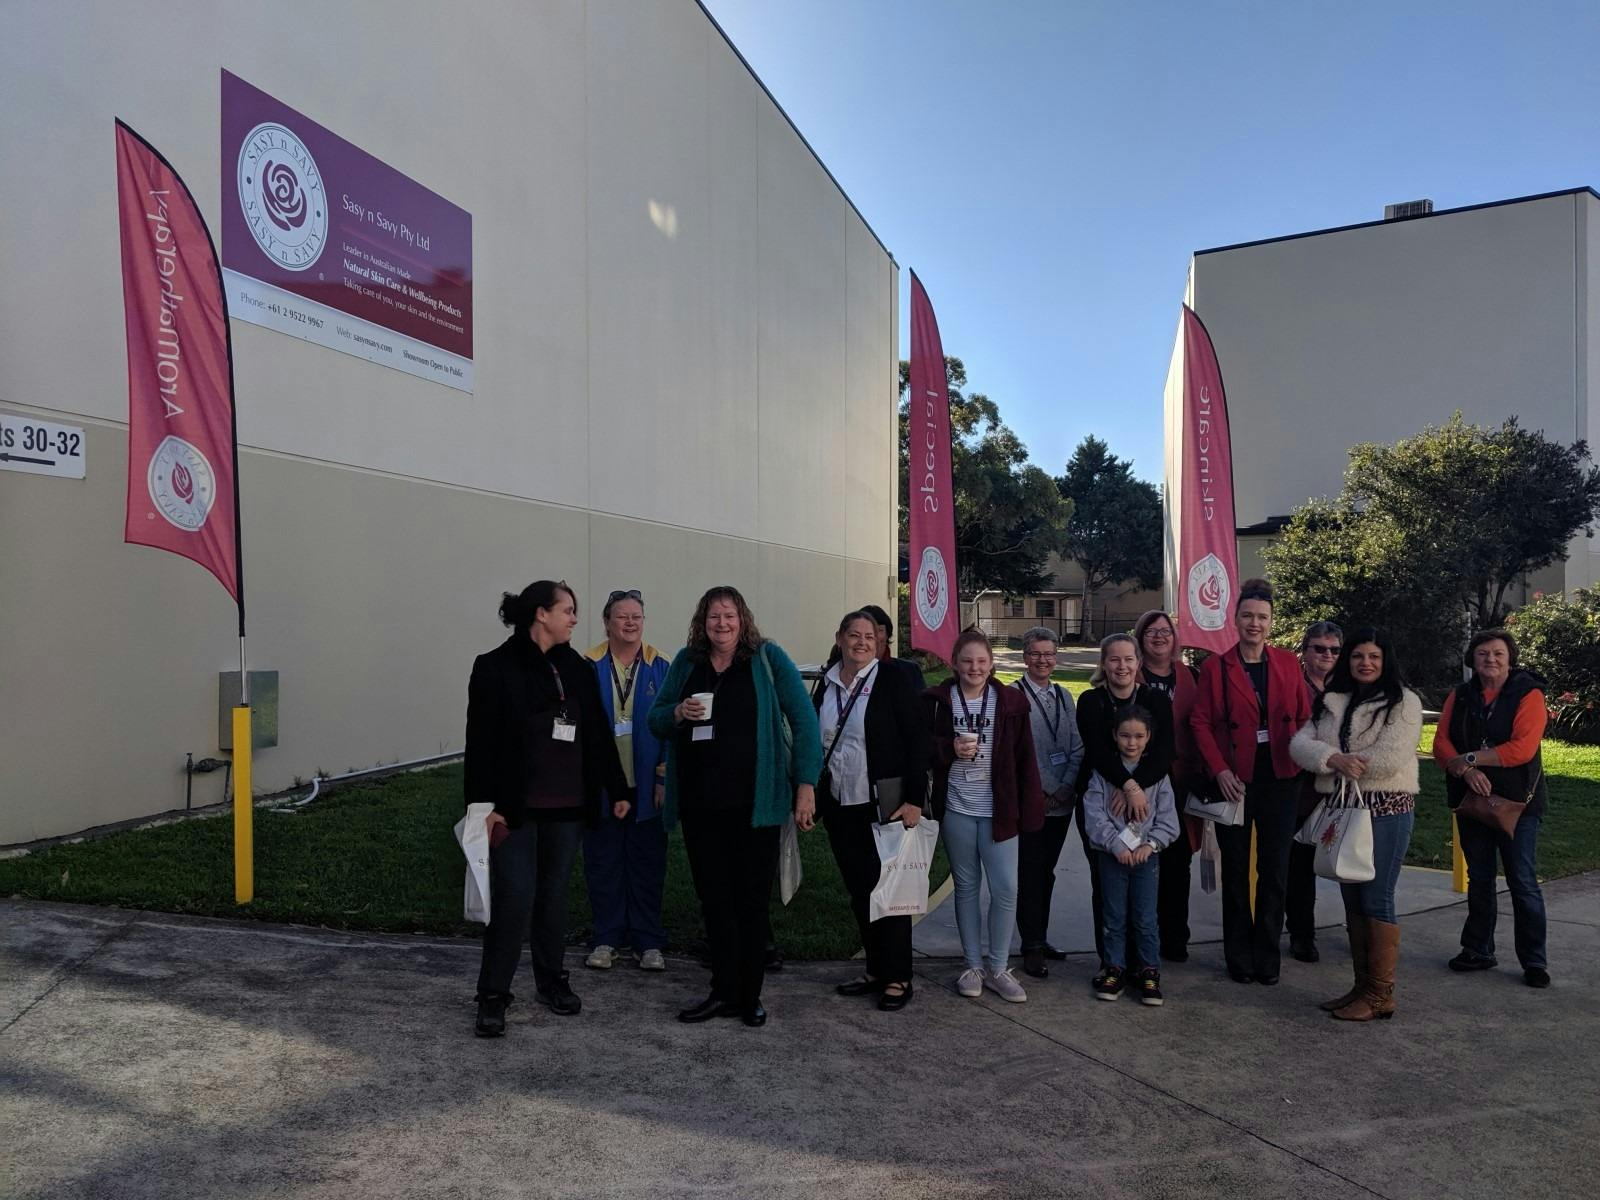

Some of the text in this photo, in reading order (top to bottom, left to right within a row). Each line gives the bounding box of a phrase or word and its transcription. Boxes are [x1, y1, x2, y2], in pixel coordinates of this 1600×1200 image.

[248, 132, 320, 191] SASY n SAVY
[246, 200, 276, 249] SASY
[295, 231, 321, 263] SAVY
[343, 194, 430, 251] Sasy n Savy Pty Ltd
[343, 242, 411, 280] Leader in Australian Made
[240, 291, 324, 328] Phone: +61 2 9522 9967
[344, 258, 462, 318] Natural Skin Care & Wellbeing Products
[344, 277, 362, 296] Taking
[363, 287, 375, 298] care
[376, 292, 382, 301] of
[395, 300, 407, 311] your
[407, 304, 418, 315] skin
[418, 309, 428, 319] and
[23, 426, 80, 457] 30-32
